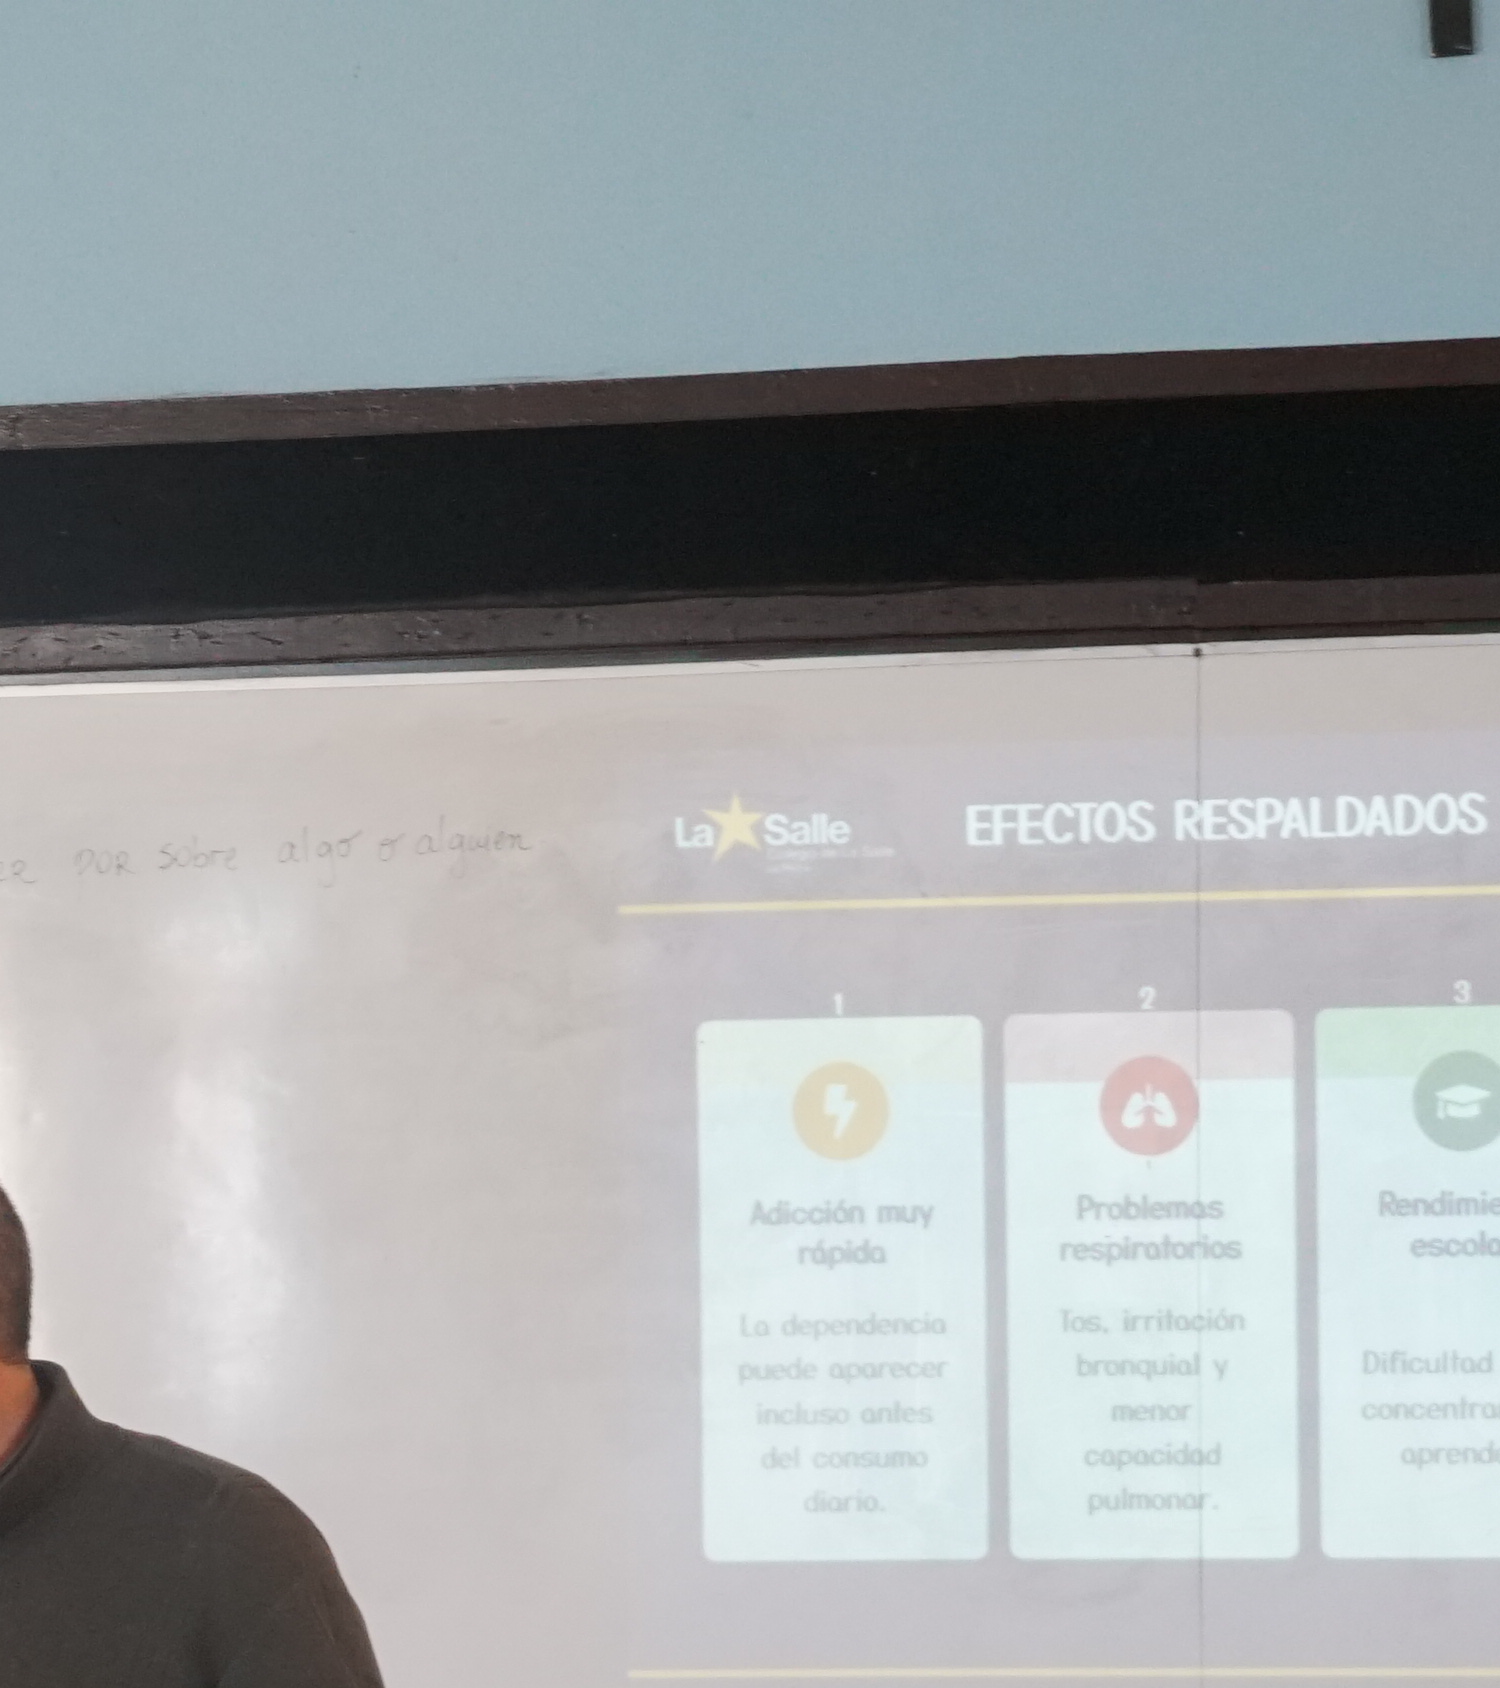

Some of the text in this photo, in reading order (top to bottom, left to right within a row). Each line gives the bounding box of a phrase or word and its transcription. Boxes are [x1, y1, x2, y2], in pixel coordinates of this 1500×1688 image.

[674, 812, 851, 848] La Salle
[966, 800, 1156, 846] EFECTOS
[1174, 793, 1488, 841] RESPALDADOS
[832, 992, 844, 1017] 1
[1137, 985, 1157, 1011] 2
[1452, 978, 1473, 1005] 3
[750, 1198, 935, 1230] Adicción muy
[1076, 1194, 1225, 1222] Problemas
[798, 1239, 889, 1271] rápida
[1059, 1234, 1243, 1268] respiratorios
[739, 1311, 948, 1342] La dependencia
[1122, 1307, 1247, 1333] irritación
[738, 1356, 950, 1387] puede aparecer
[1076, 1351, 1229, 1383] bronquial y
[1361, 1349, 1494, 1375] Dificultad
[756, 1400, 935, 1426] incluso antes
[1111, 1403, 1193, 1422] menor
[760, 1446, 929, 1470] del consumo
[1083, 1441, 1222, 1472] capacidad
[803, 1489, 887, 1514] diario.
[1087, 1486, 1220, 1517] pulmonar.
